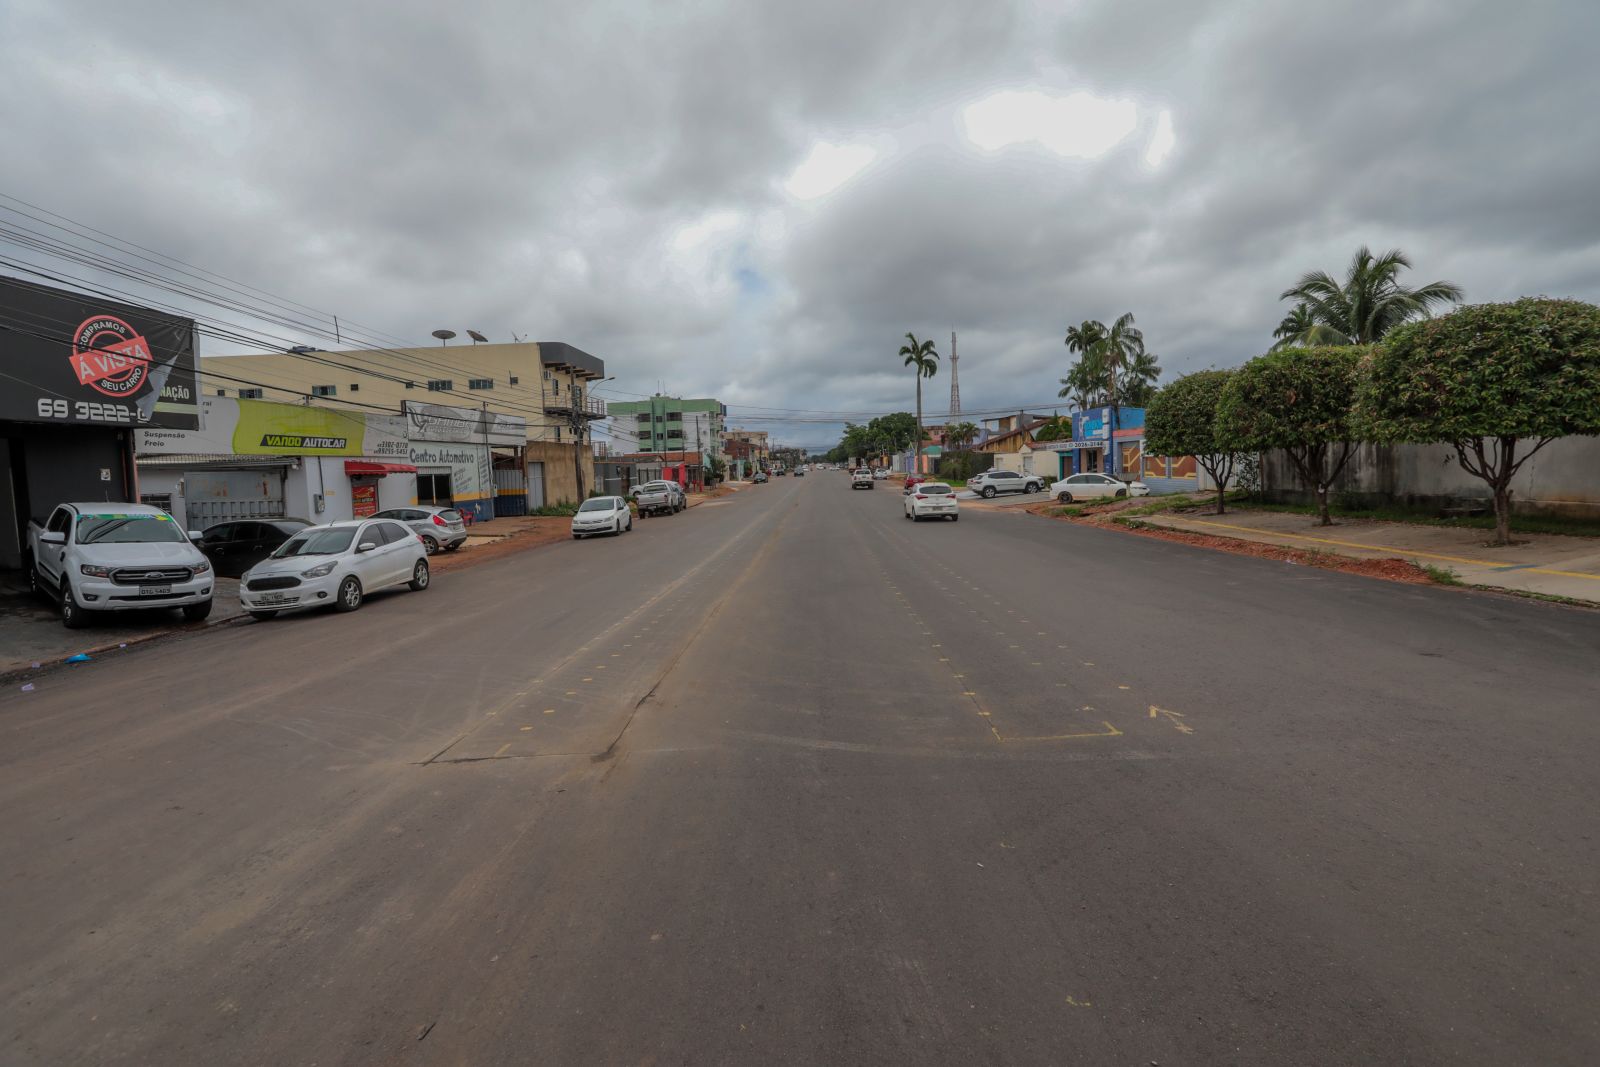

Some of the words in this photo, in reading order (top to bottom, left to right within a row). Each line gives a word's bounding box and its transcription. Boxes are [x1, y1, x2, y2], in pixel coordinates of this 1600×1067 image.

[80, 356, 95, 379] Á
[94, 344, 148, 372] VISTA
[101, 379, 119, 391] SEU
[119, 367, 142, 391] CARRO
[160, 385, 190, 401] NAÇÃO
[37, 398, 69, 419] 69
[144, 430, 186, 439] Suspensão
[265, 435, 302, 447] VANDO
[302, 437, 345, 448] AUTOCAR
[409, 448, 437, 463] Centro
[438, 449, 474, 464] Automotivo
